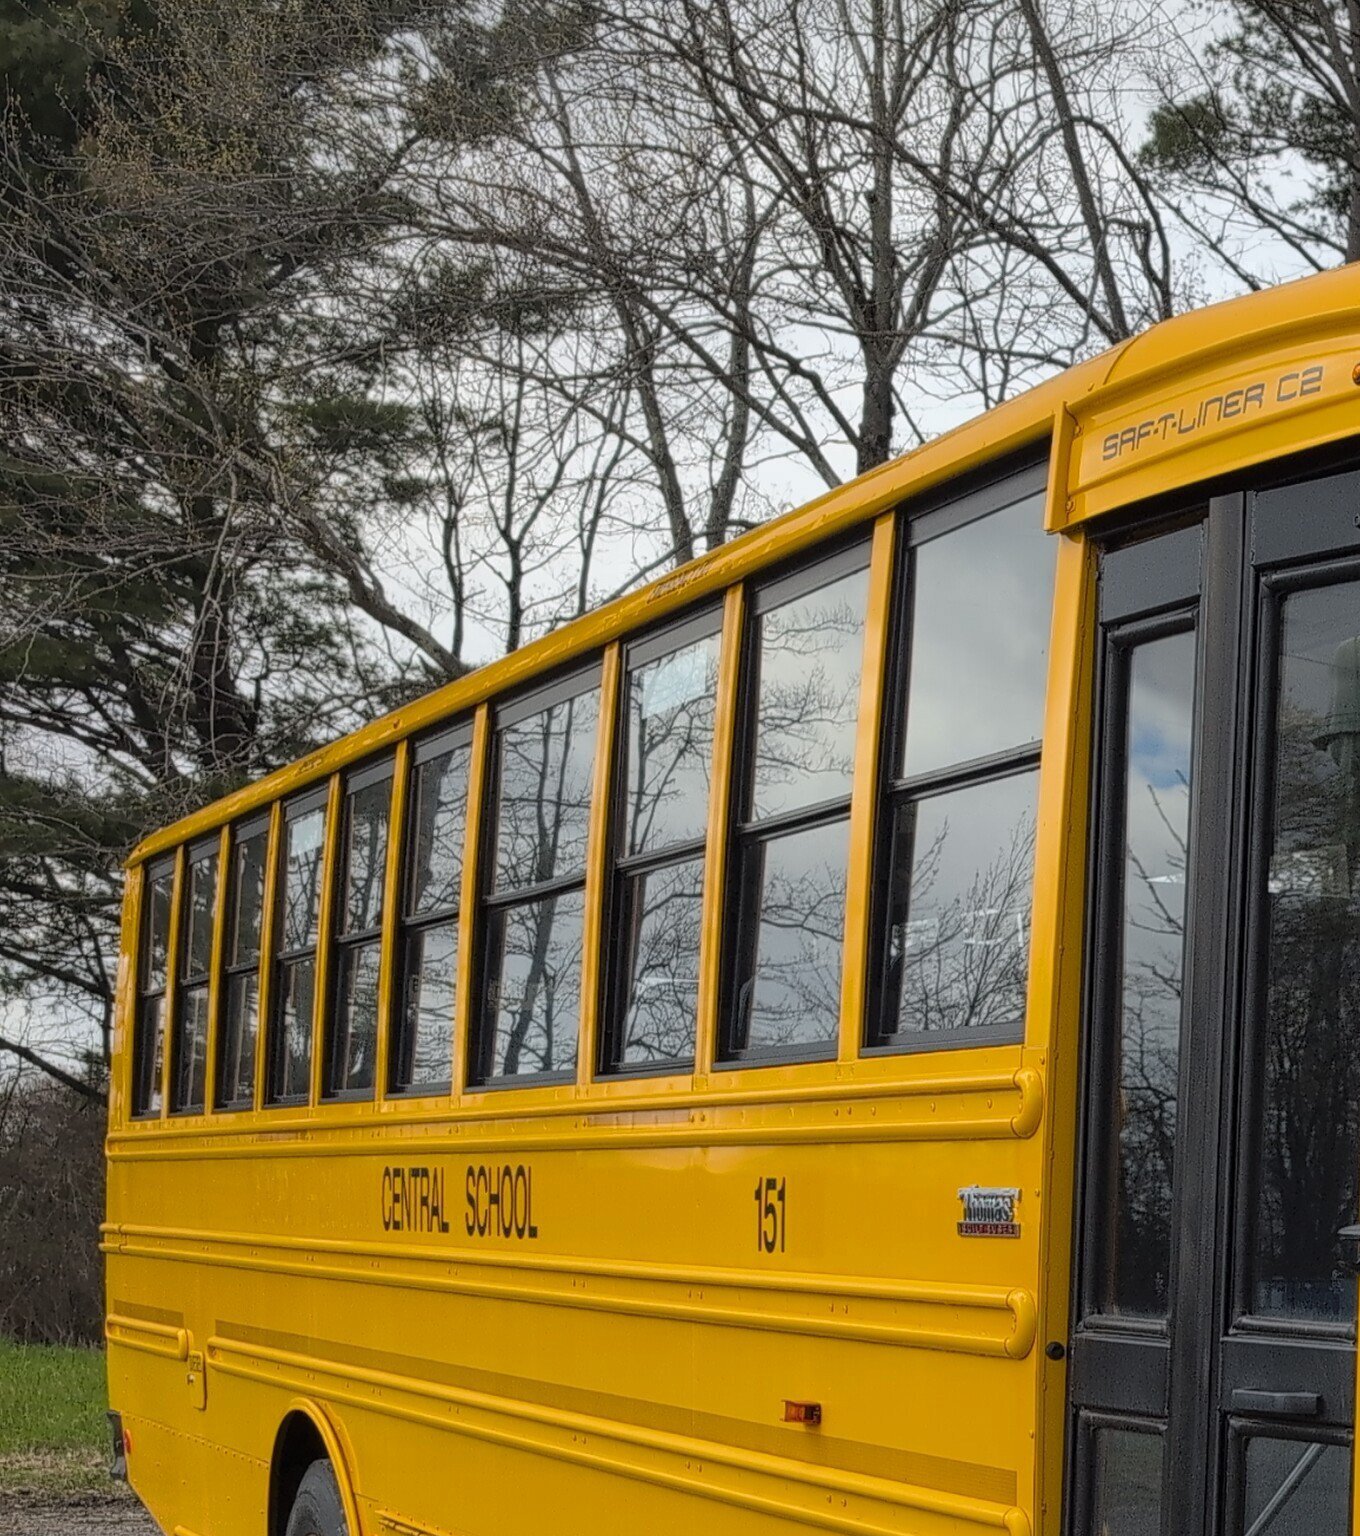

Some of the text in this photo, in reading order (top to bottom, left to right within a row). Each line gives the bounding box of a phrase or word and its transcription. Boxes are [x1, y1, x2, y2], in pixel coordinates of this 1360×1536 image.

[1277, 366, 1324, 402] C2
[382, 1164, 539, 1239] CENTRAL SCHOOL
[754, 1176, 787, 1253] 151
